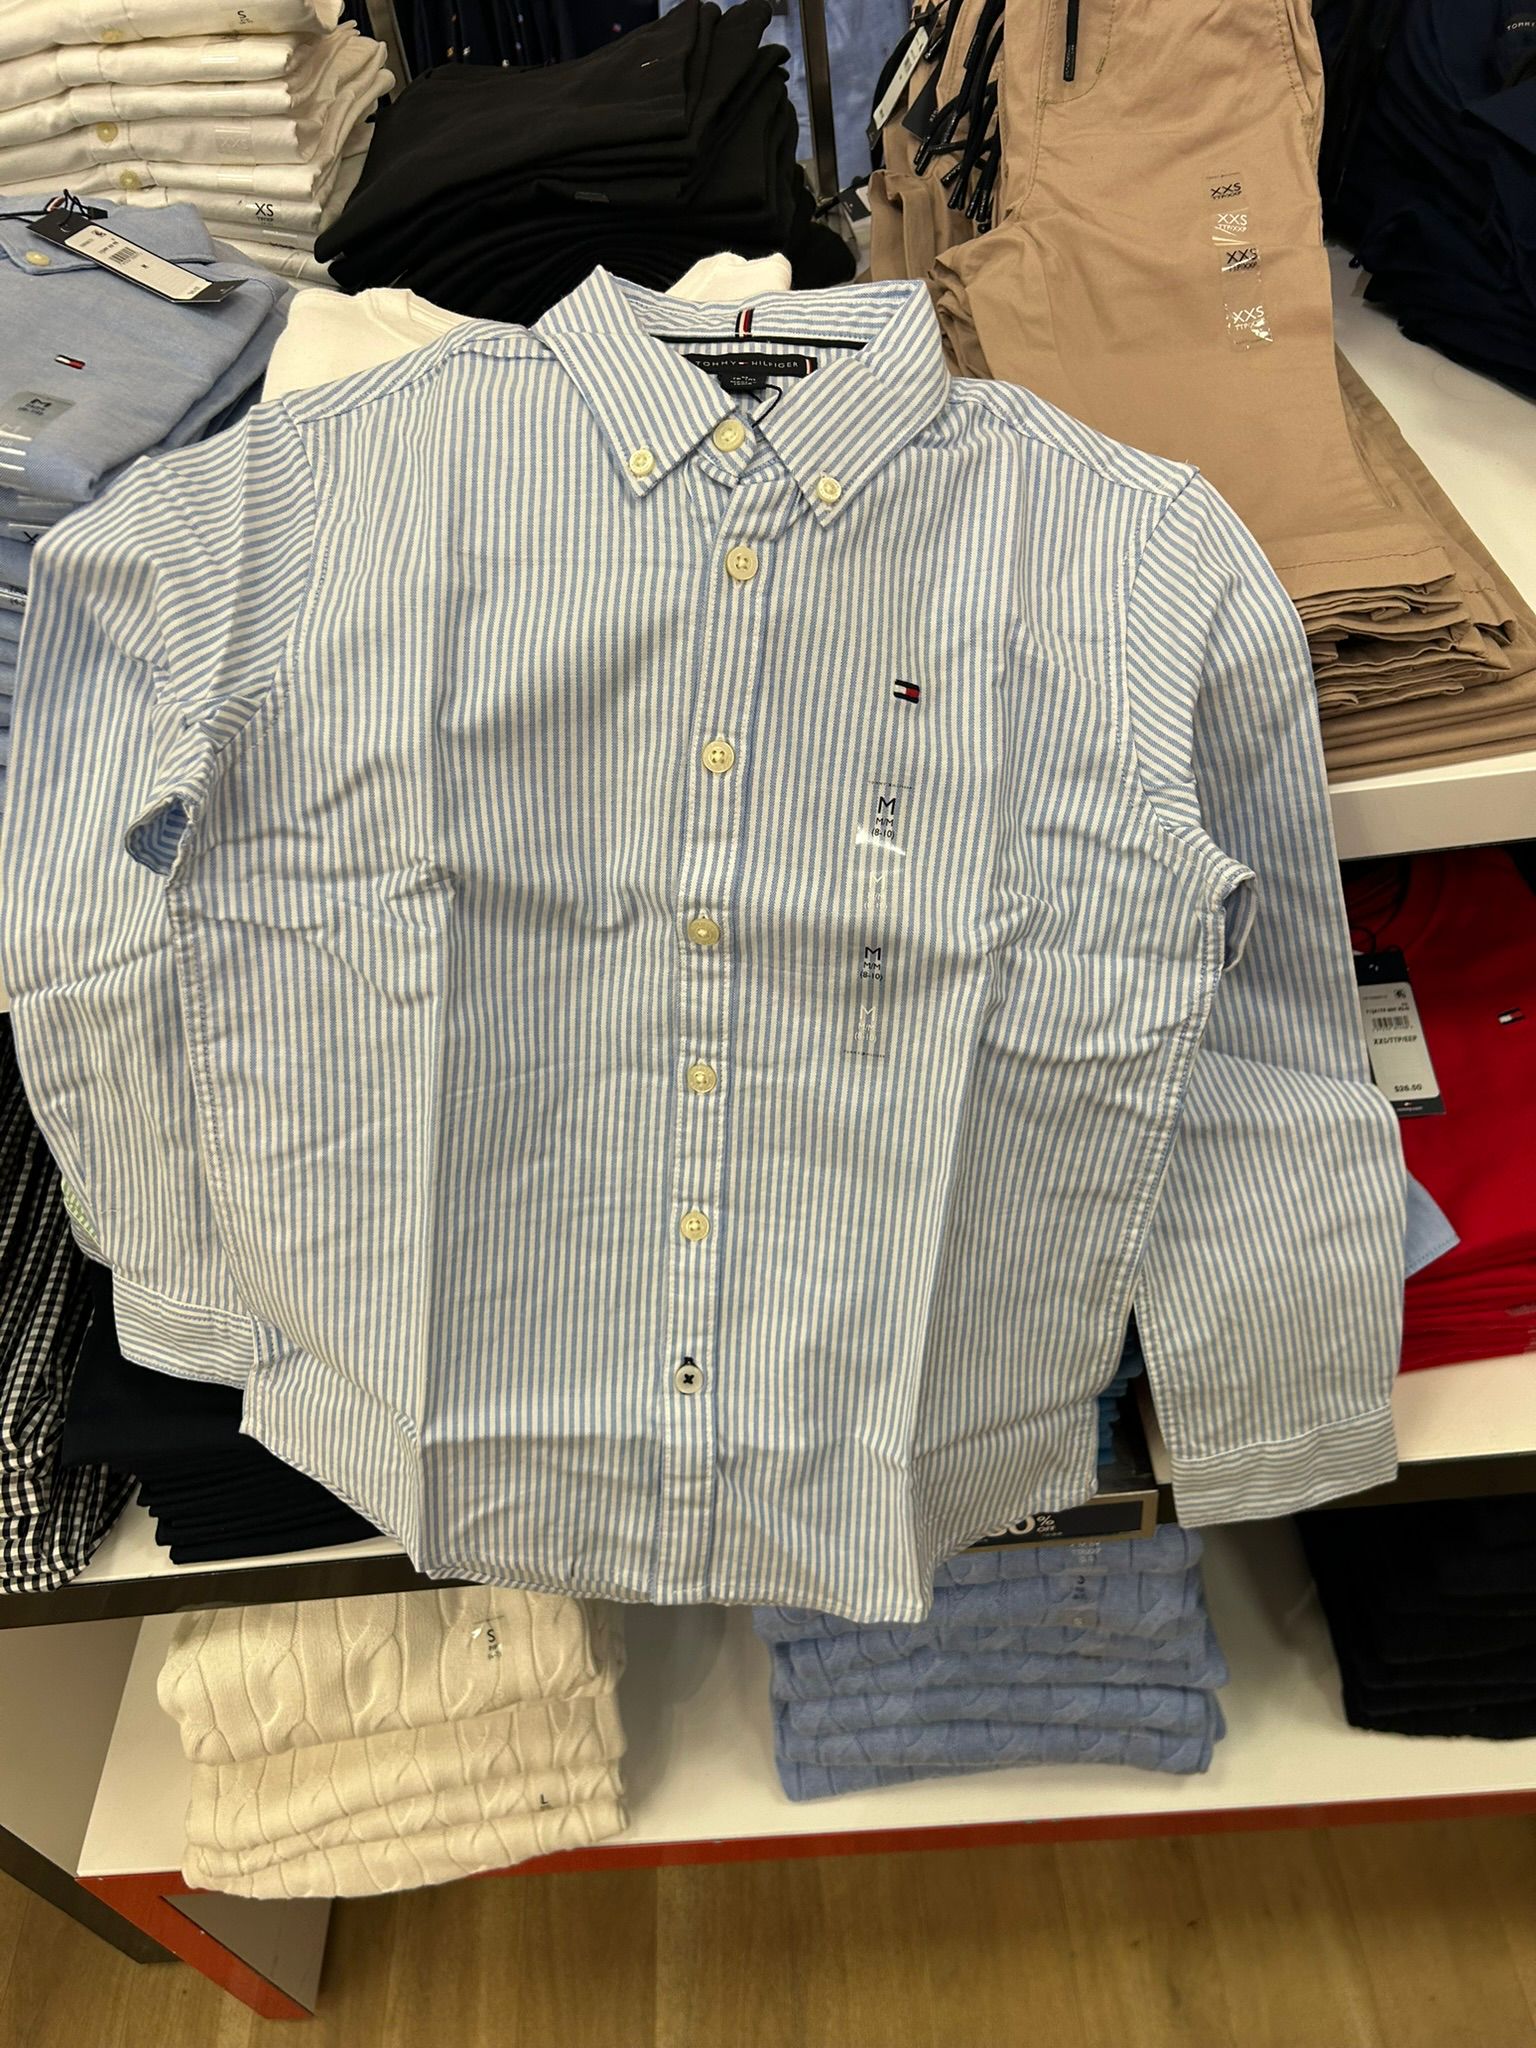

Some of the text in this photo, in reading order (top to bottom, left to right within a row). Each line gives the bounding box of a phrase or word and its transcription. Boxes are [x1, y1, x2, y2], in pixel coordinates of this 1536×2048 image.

[237, 10, 246, 19] S
[1210, 182, 1242, 197] XXS
[254, 202, 274, 217] XS
[1217, 213, 1248, 226] XXS
[1226, 248, 1258, 264] XXS
[1232, 305, 1265, 324] XXS
[751, 360, 799, 369] HILFIGER
[877, 796, 896, 815] M
[875, 817, 894, 827] M/M
[871, 828, 895, 840] (8-10)
[864, 947, 882, 960] M
[863, 962, 881, 970] M/M
[859, 970, 883, 981] (8-10)
[859, 1004, 876, 1021] M
[487, 1628, 496, 1643] S
[541, 1793, 549, 1804] L
